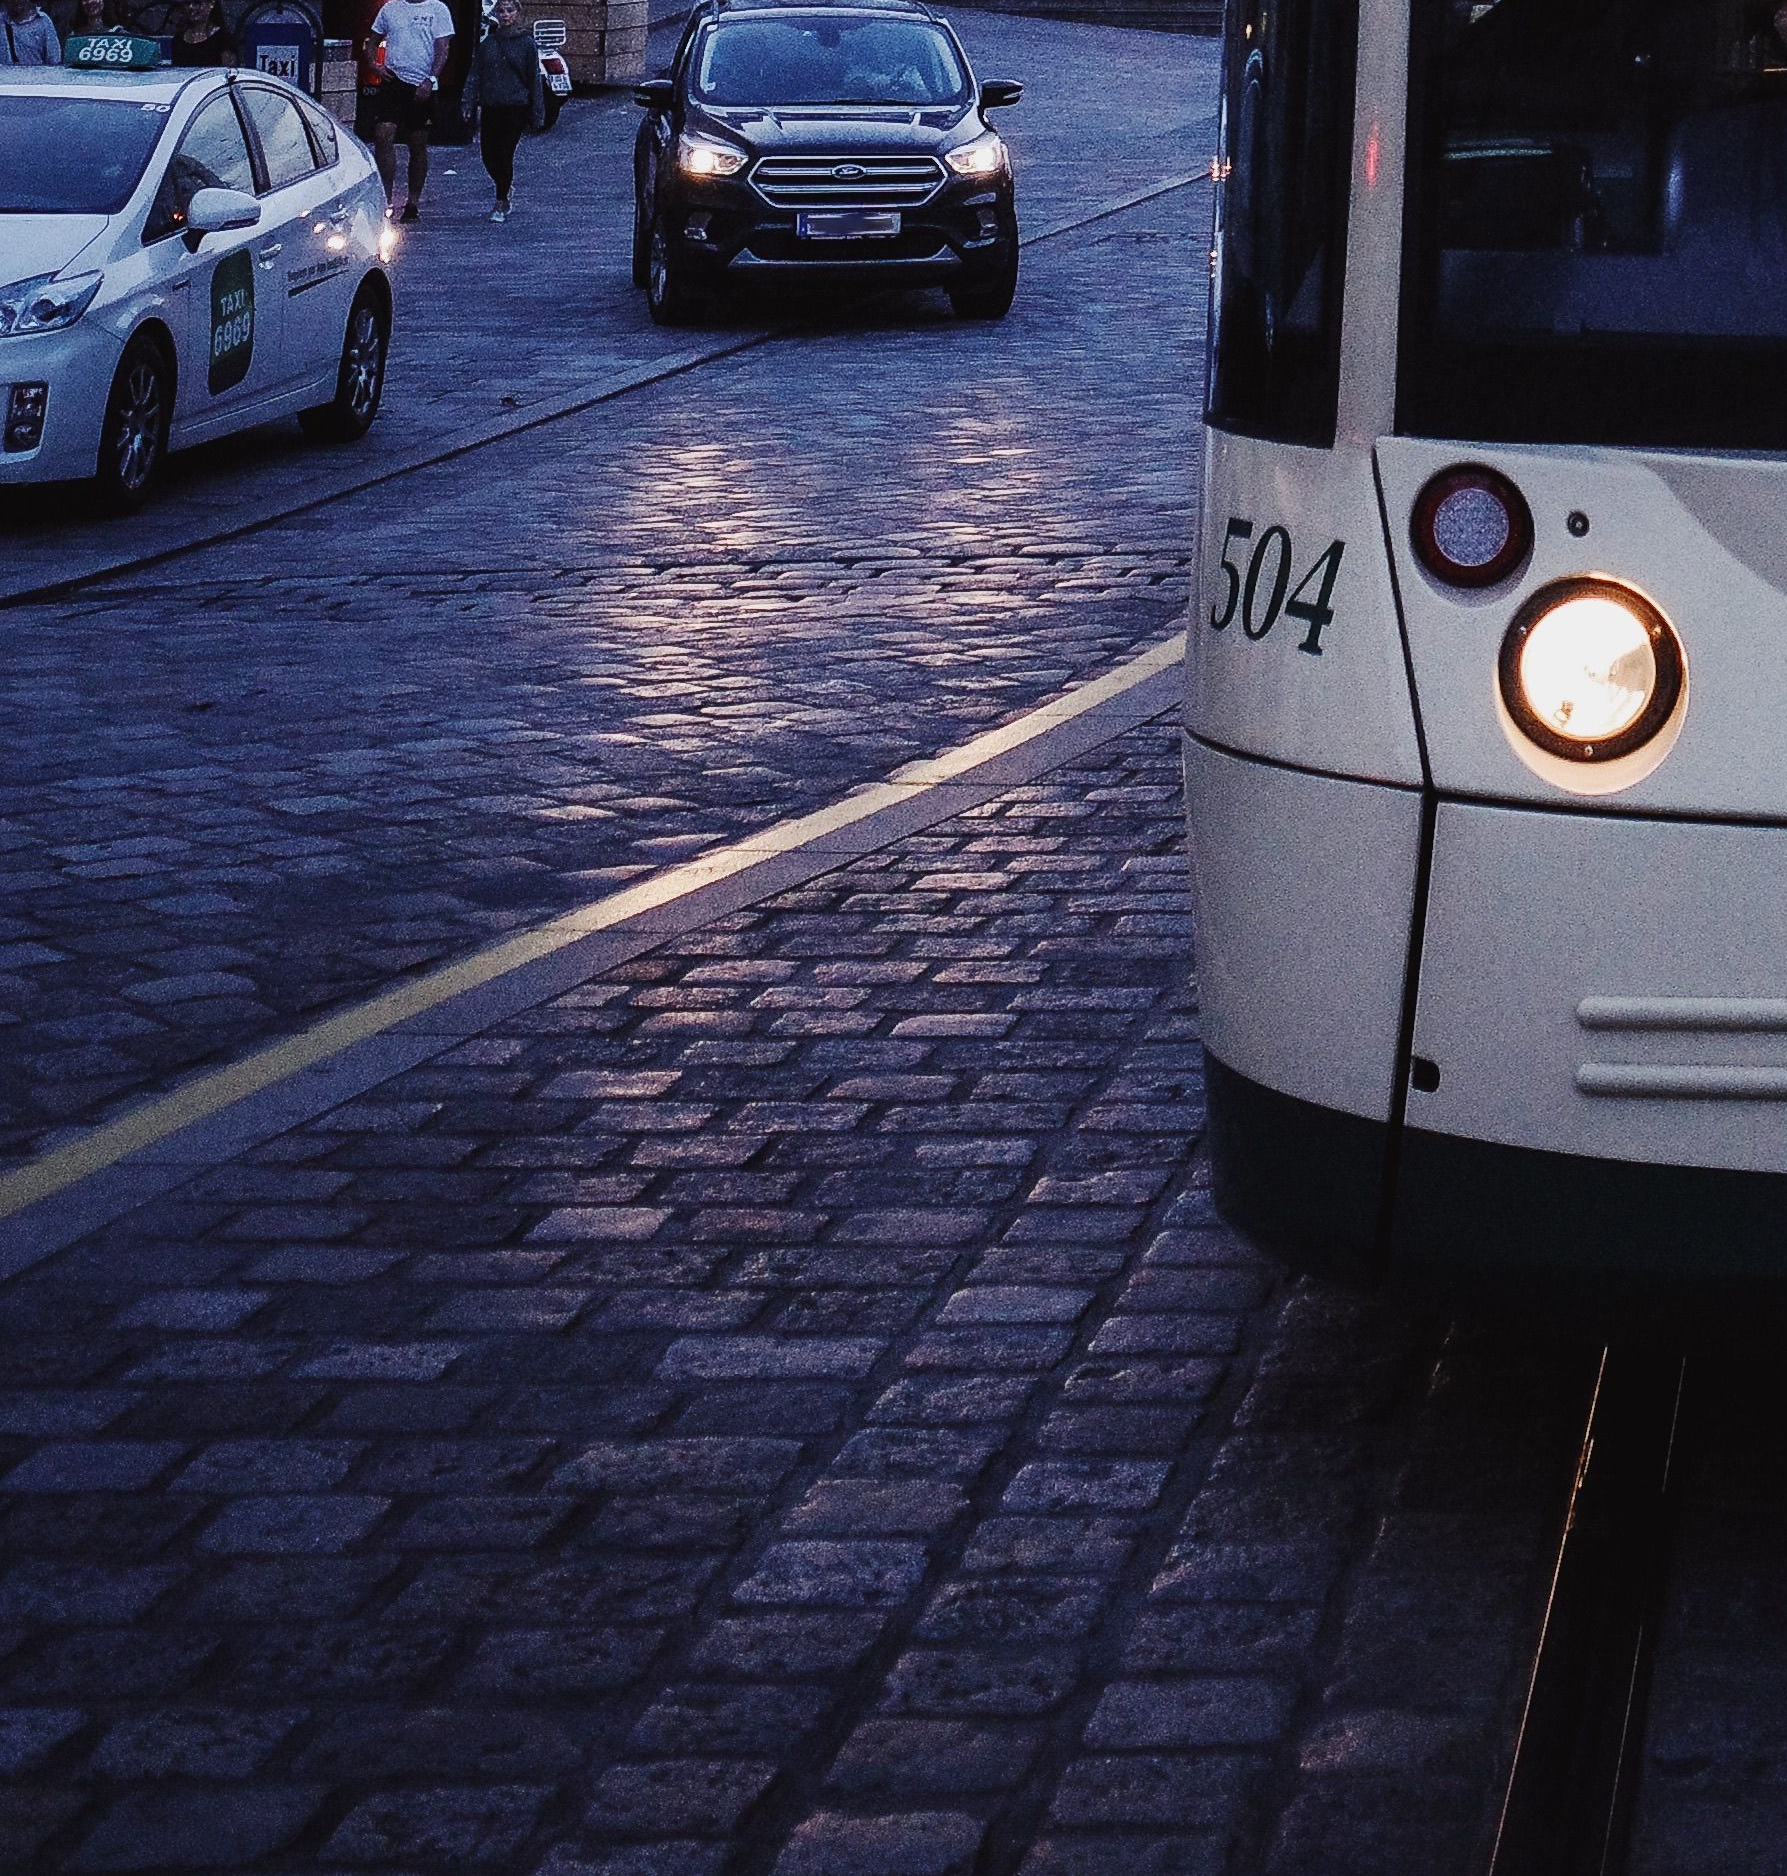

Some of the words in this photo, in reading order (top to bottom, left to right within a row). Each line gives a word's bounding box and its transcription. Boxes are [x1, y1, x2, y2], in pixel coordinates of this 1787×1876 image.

[78, 47, 133, 63] 6969
[88, 38, 132, 49] TAXI
[260, 55, 295, 77] Taxi
[220, 289, 246, 317] TAXI
[214, 311, 250, 357] 6969
[1210, 517, 1346, 656] 504
